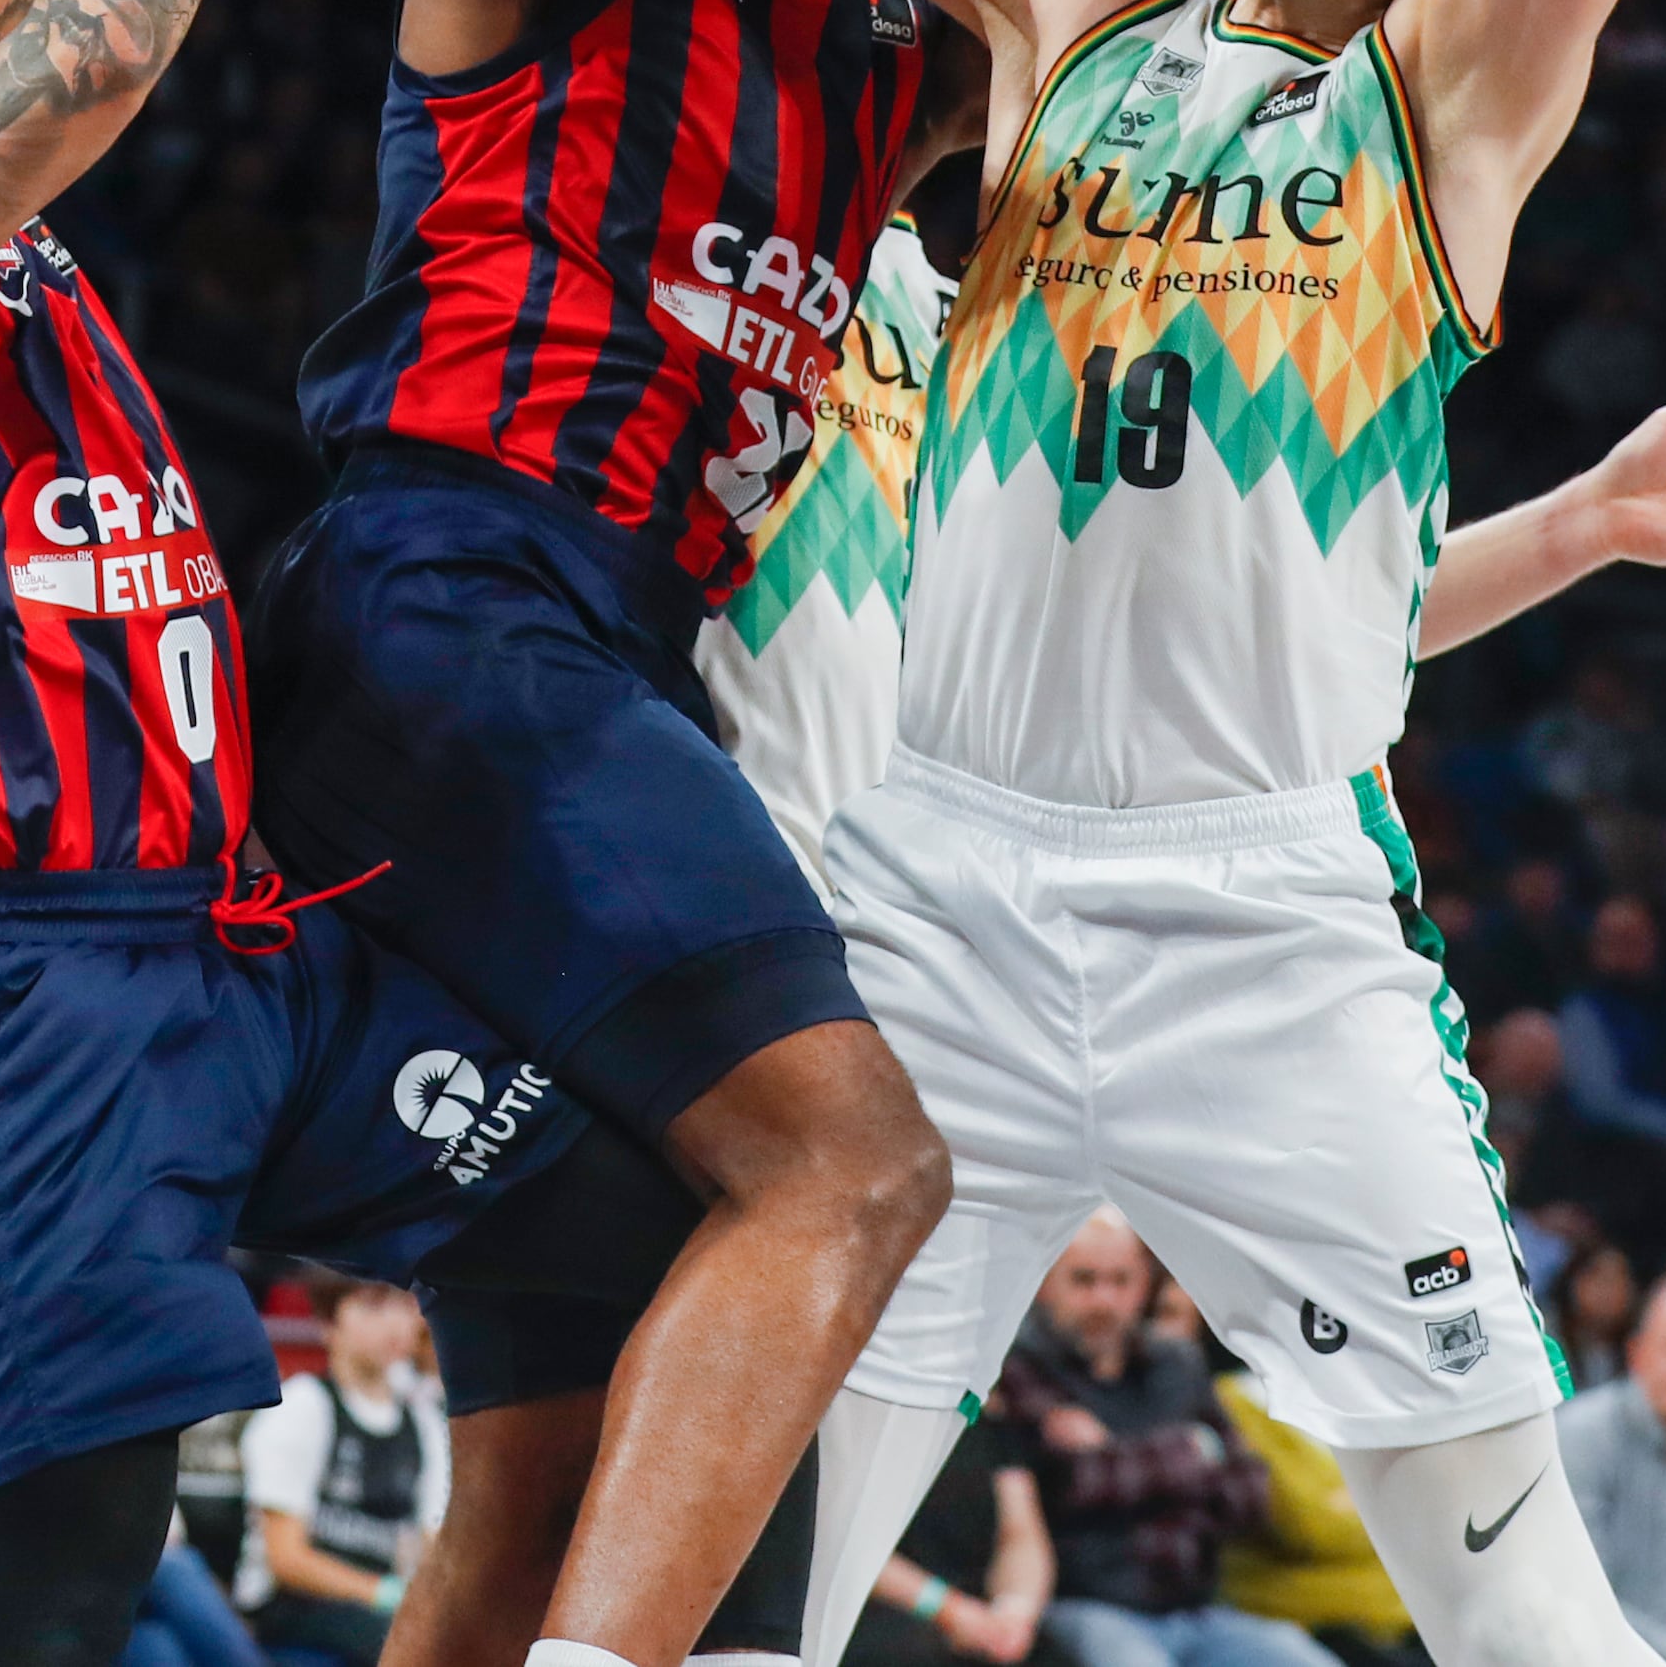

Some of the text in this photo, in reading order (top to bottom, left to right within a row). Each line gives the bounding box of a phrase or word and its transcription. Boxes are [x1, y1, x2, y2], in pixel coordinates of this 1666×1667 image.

[1121, 266, 1144, 291] &
[1150, 262, 1339, 300] pensiones
[727, 305, 797, 385] ETL
[1074, 344, 1193, 490] 19
[102, 550, 182, 614] ETL
[157, 615, 216, 764] 0
[434, 1129, 467, 1171] GRUPO
[1413, 1265, 1460, 1294] acb
